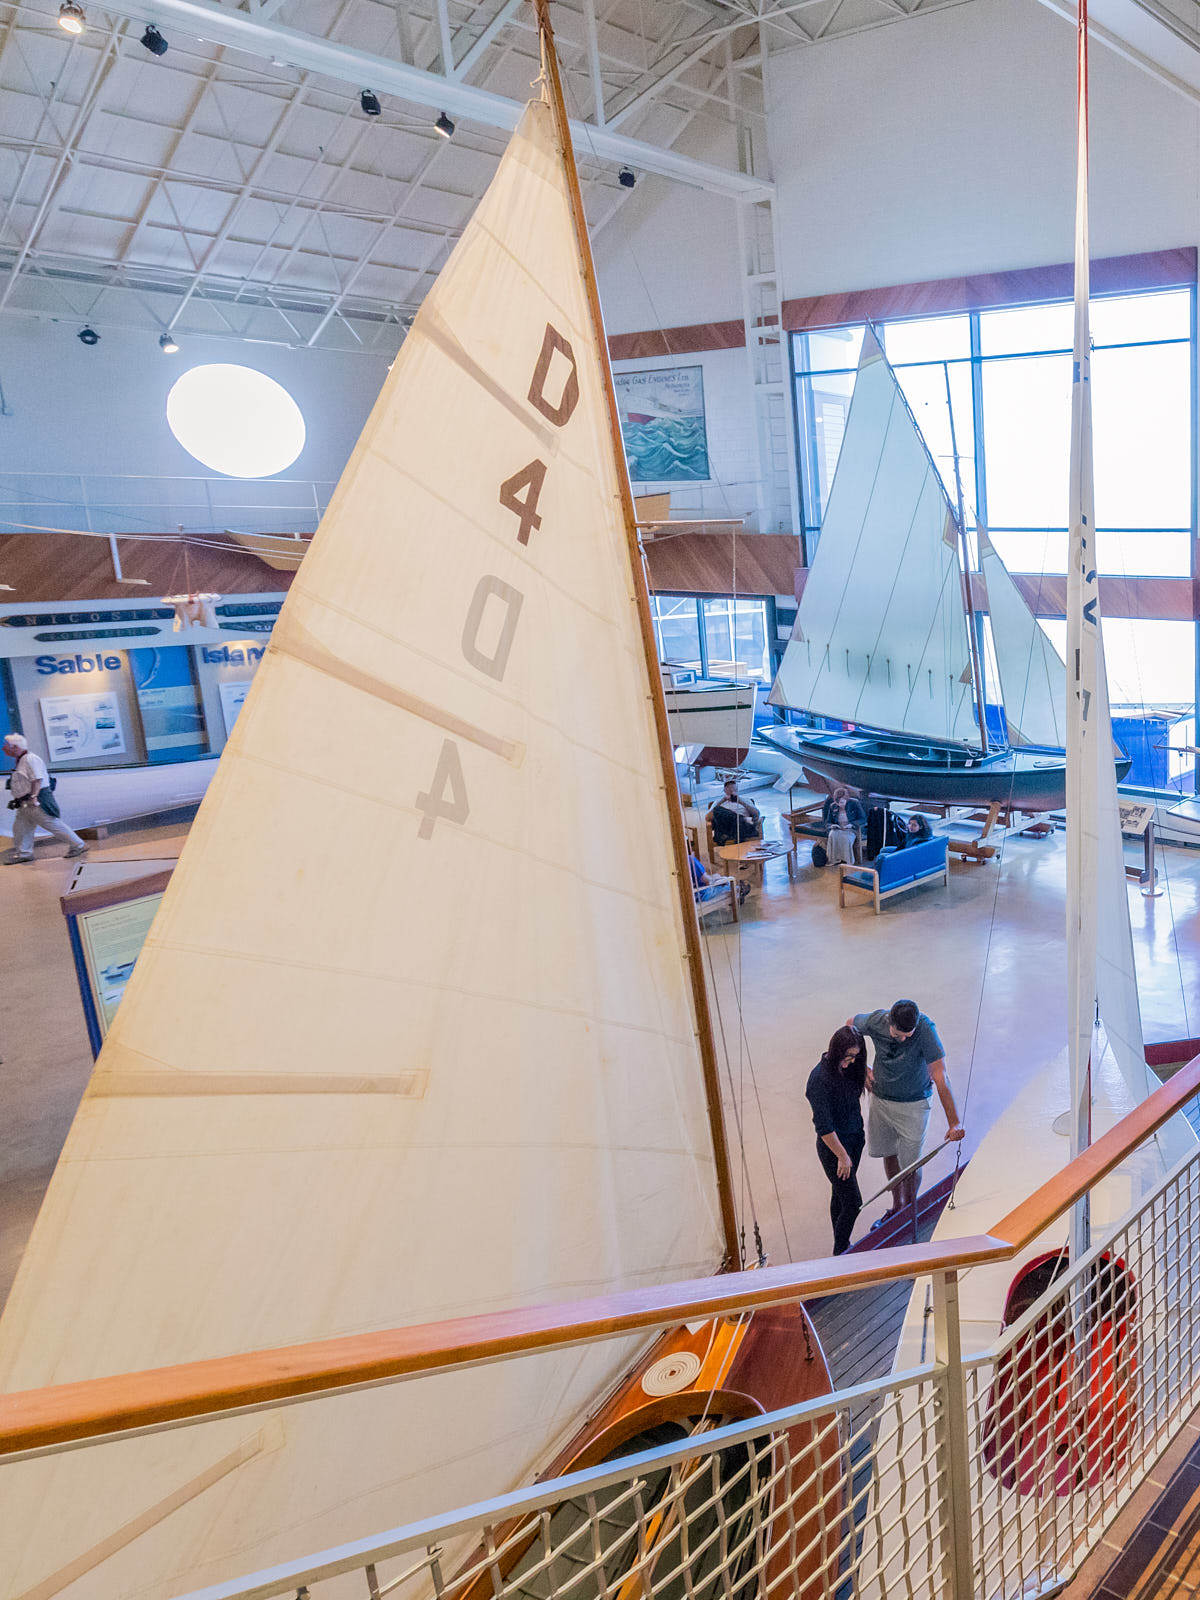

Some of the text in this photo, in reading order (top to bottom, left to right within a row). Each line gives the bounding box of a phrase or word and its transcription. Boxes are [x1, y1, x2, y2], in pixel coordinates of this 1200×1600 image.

[528, 322, 580, 428] D
[500, 458, 548, 547] 4
[24, 610, 159, 625] NICOSIA
[35, 646, 267, 675] Sable Islan
